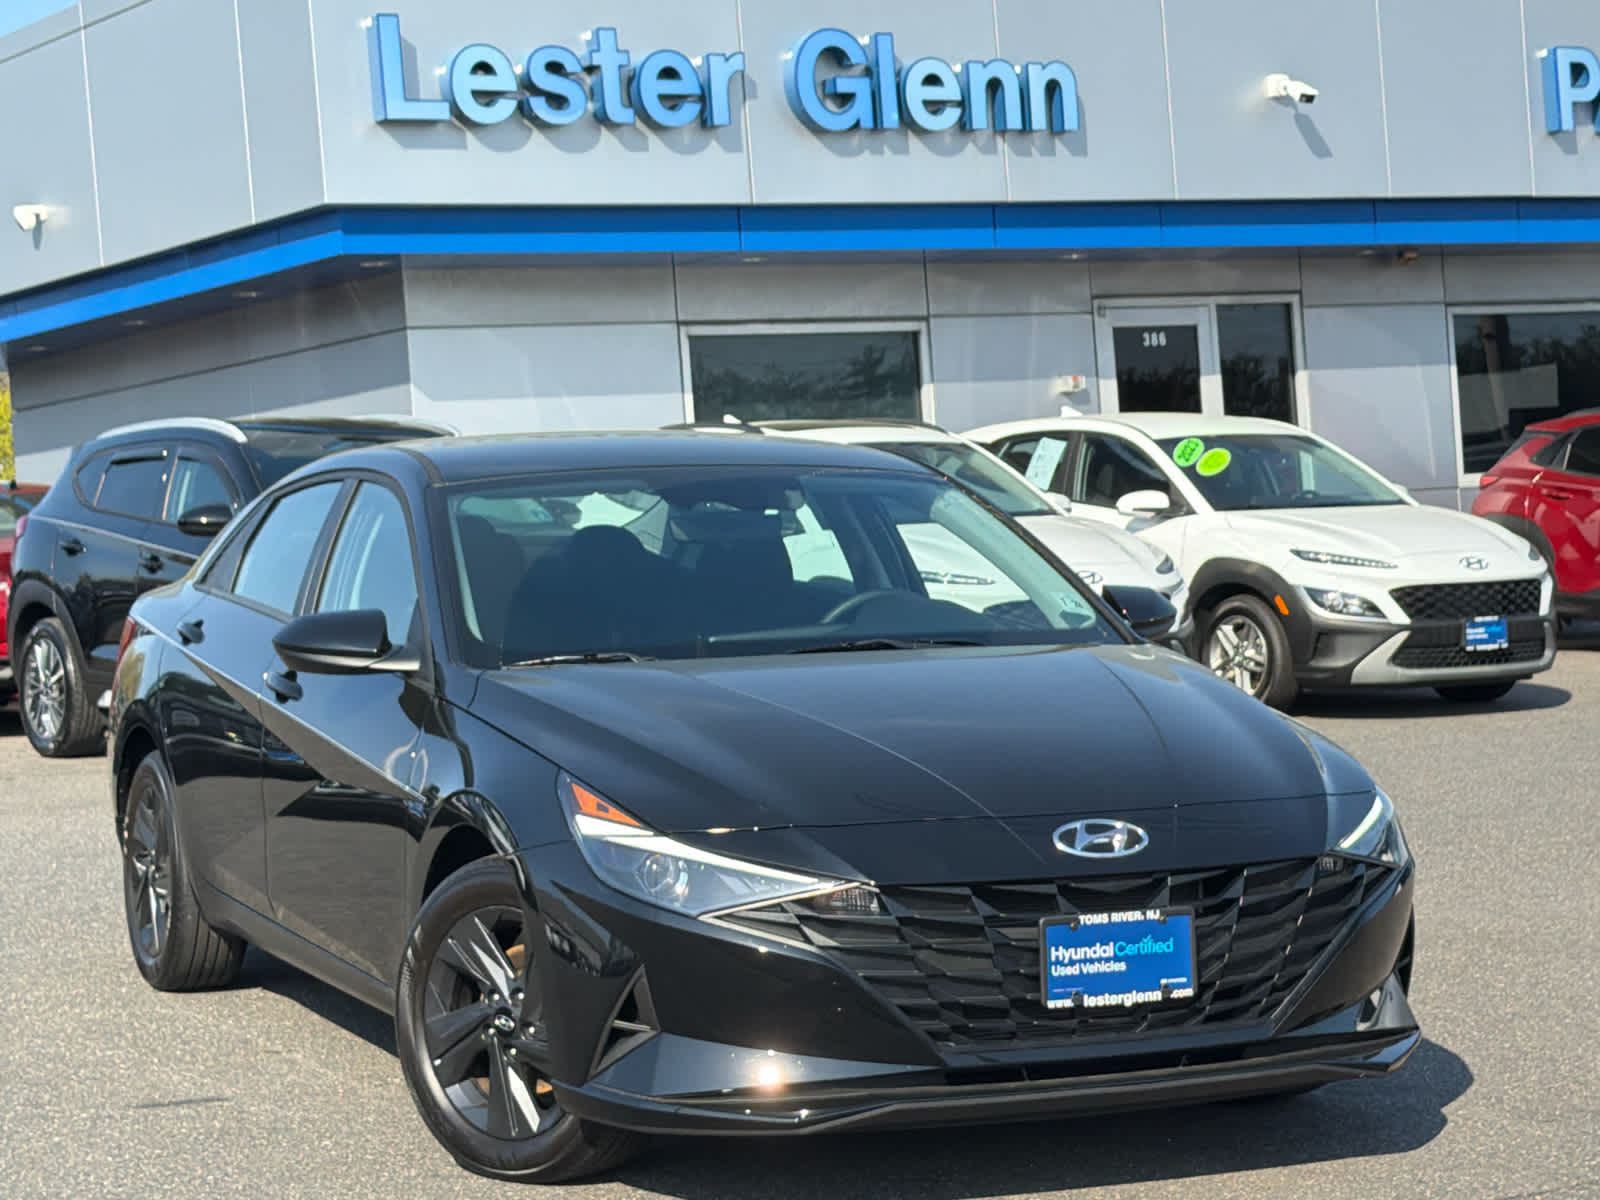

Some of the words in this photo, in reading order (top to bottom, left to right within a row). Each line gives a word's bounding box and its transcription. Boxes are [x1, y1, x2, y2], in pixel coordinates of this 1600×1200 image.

[367, 13, 745, 128] Lester
[786, 28, 1080, 133] Glenn
[1542, 46, 1600, 136] P
[1078, 912, 1109, 926] TOMS
[1146, 909, 1160, 921] NJ
[1050, 941, 1114, 964] Hyundai
[1115, 935, 1174, 957] Certified
[1051, 964, 1080, 977] Used
[1081, 960, 1127, 974] Vehicles
[1083, 990, 1162, 1008] lesterglenn
